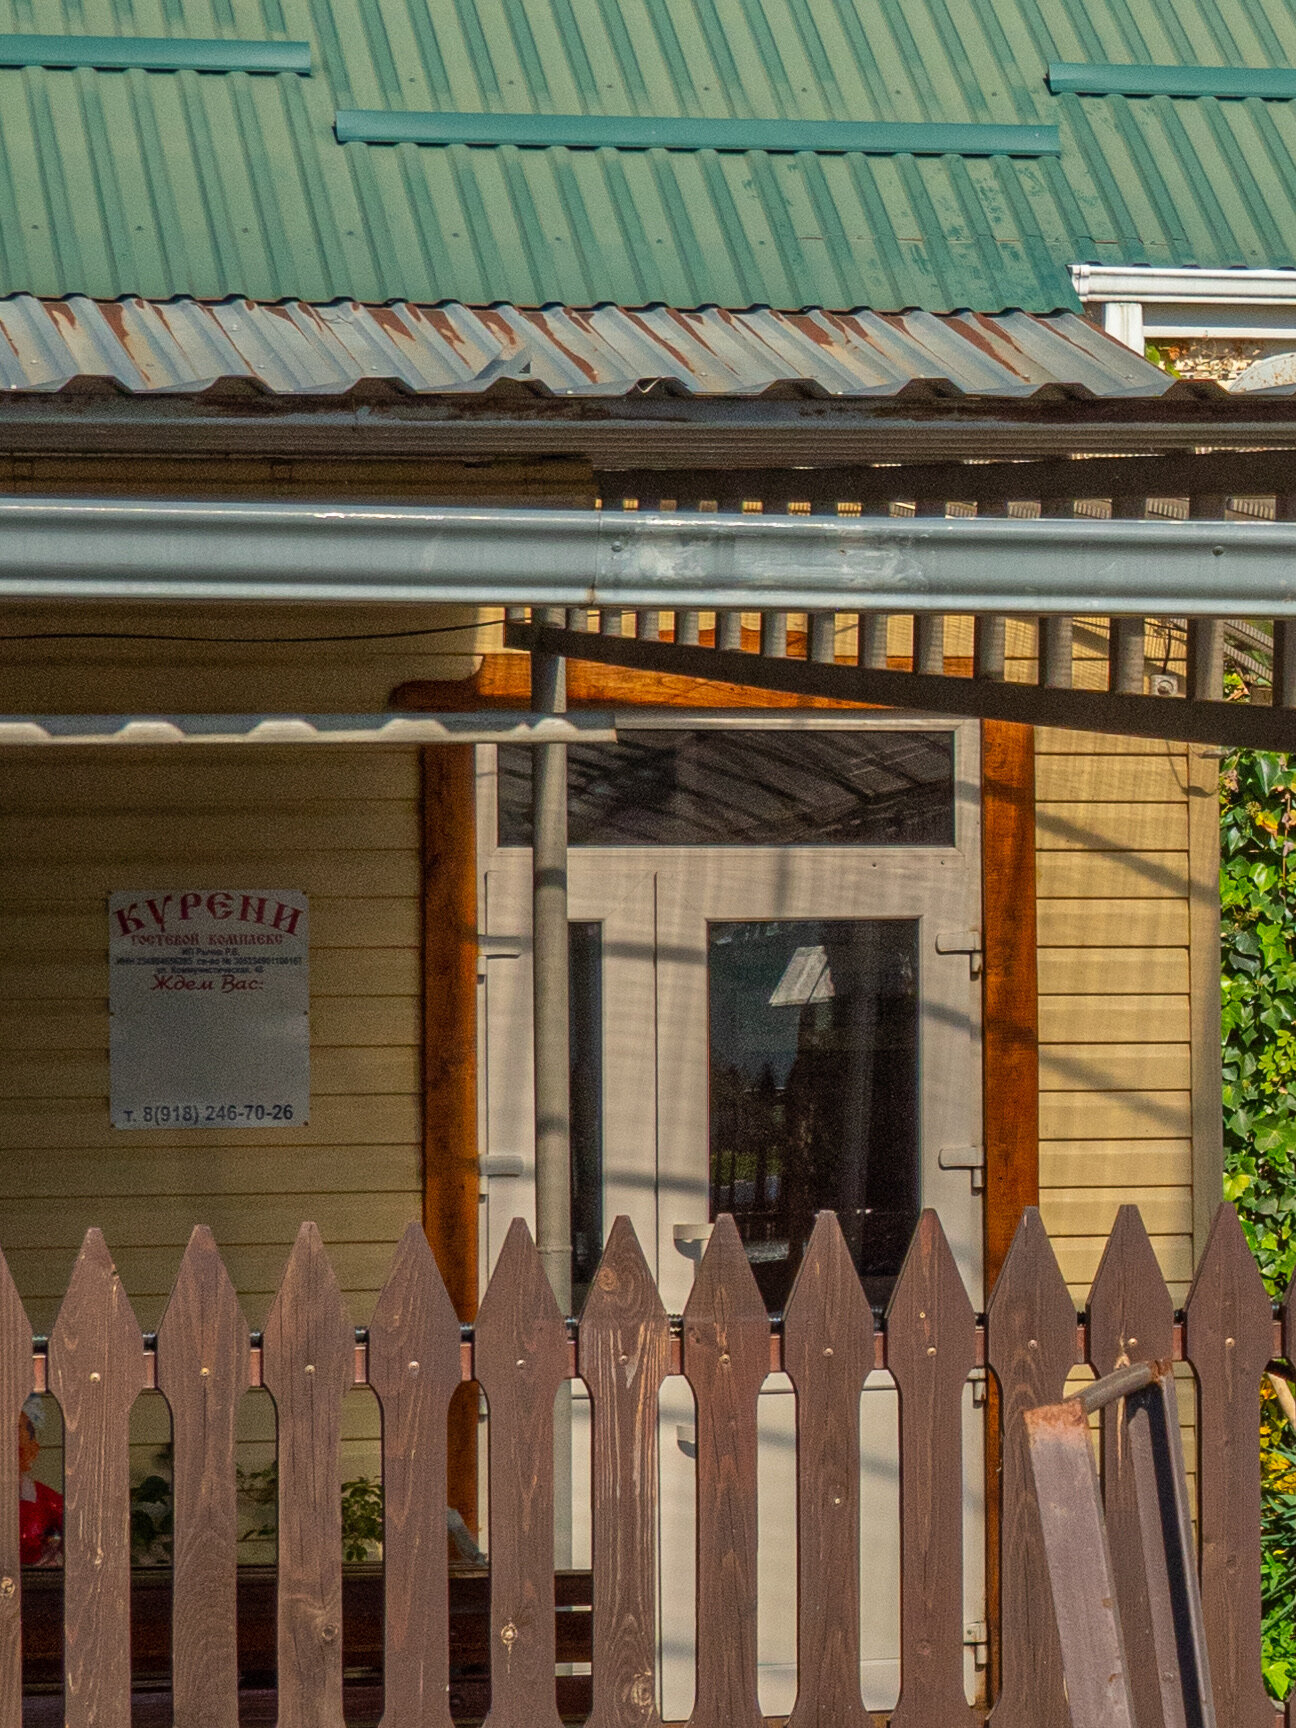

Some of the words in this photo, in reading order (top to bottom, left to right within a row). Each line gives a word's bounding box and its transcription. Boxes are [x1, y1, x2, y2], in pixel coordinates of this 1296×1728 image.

[113, 891, 304, 937] КУРЕНИ
[131, 933, 199, 946] ГОСТЕВОЙ
[208, 933, 283, 946] КОМПЛЕКС
[150, 974, 214, 991] Ждем
[221, 974, 265, 994] Вас:
[142, 1104, 199, 1125] 8(918)
[204, 1103, 294, 1122] 246-70-26
